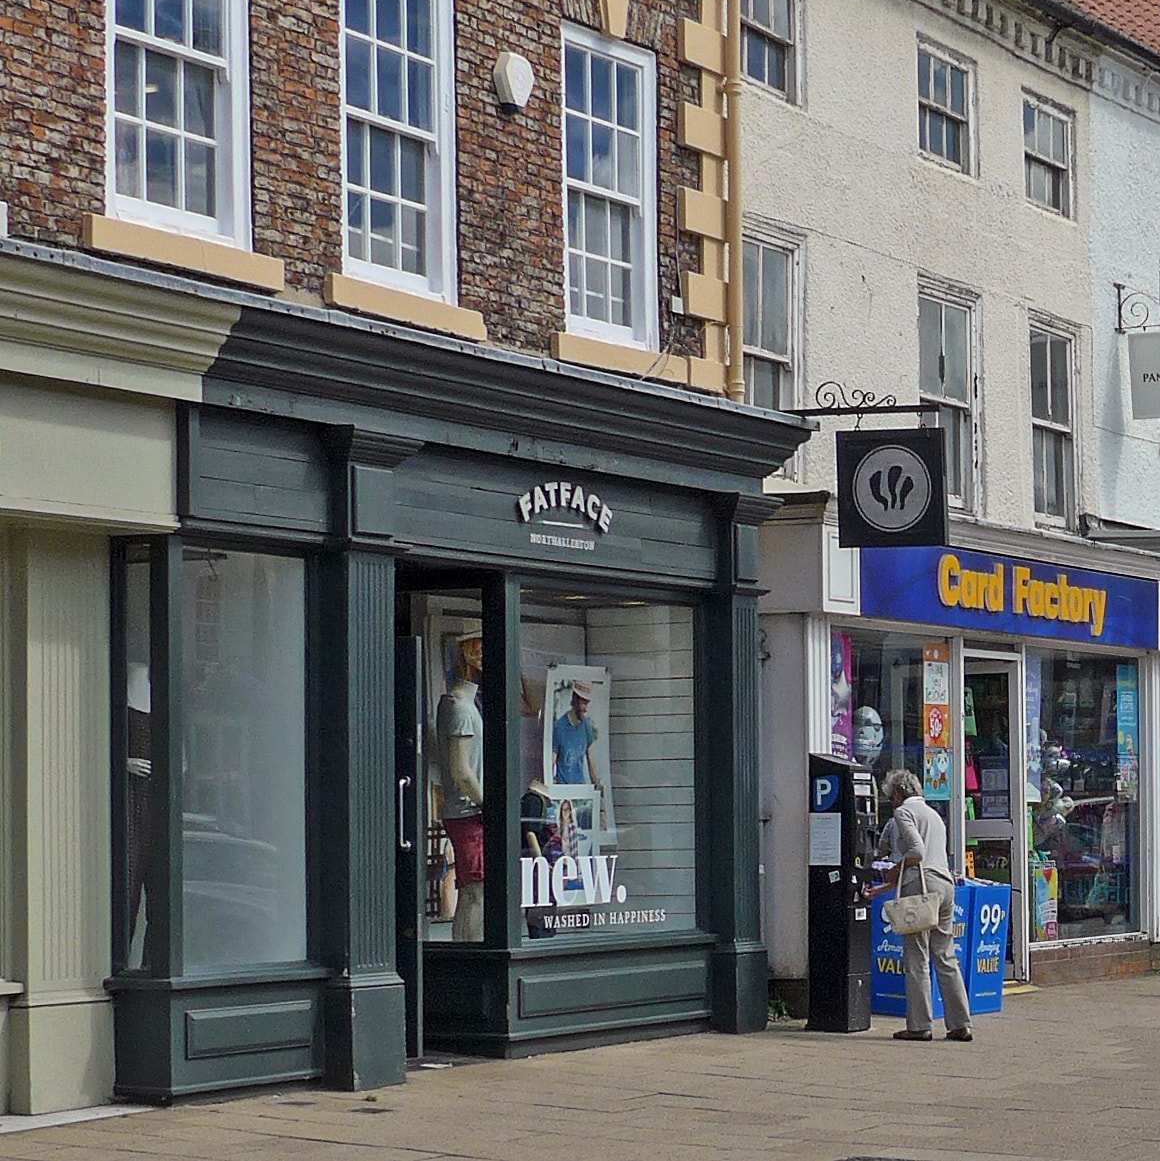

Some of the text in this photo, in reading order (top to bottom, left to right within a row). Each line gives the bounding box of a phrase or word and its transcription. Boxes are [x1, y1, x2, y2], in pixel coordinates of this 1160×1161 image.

[519, 481, 613, 533] FATFACE
[938, 554, 1107, 636] Card Factory
[816, 778, 832, 806] P
[544, 909, 666, 929] WASHED IN HAPPINESS
[877, 957, 903, 975] VAL
[976, 957, 1000, 974] VALUE
